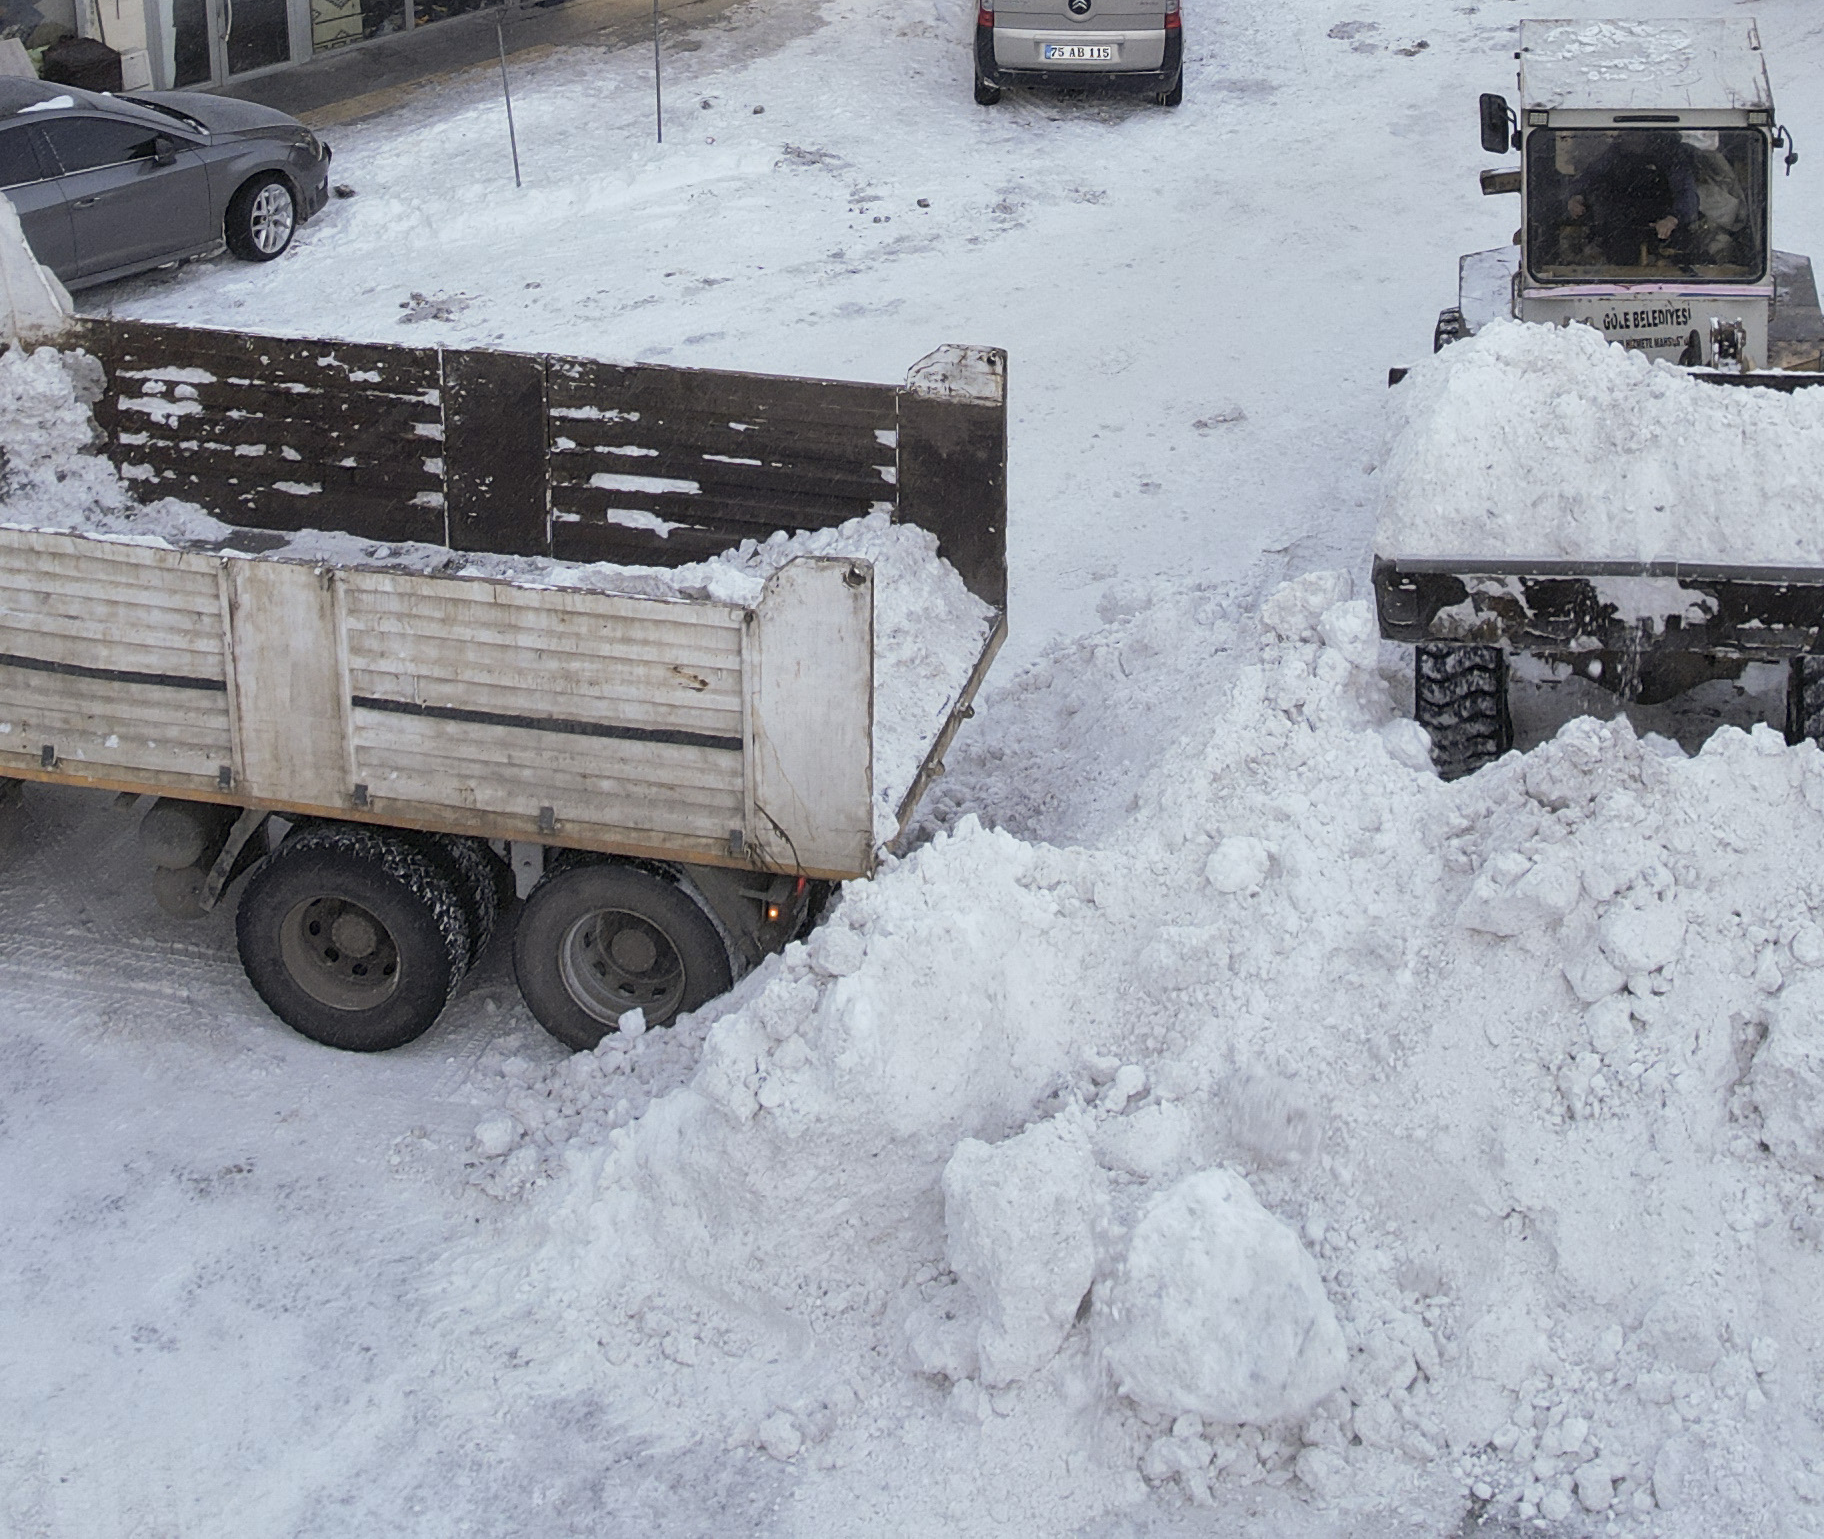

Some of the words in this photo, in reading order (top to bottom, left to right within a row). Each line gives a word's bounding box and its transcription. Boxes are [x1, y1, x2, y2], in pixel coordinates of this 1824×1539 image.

[1051, 47, 1065, 58] 75
[1069, 47, 1085, 58] AB
[1090, 47, 1110, 58] 115
